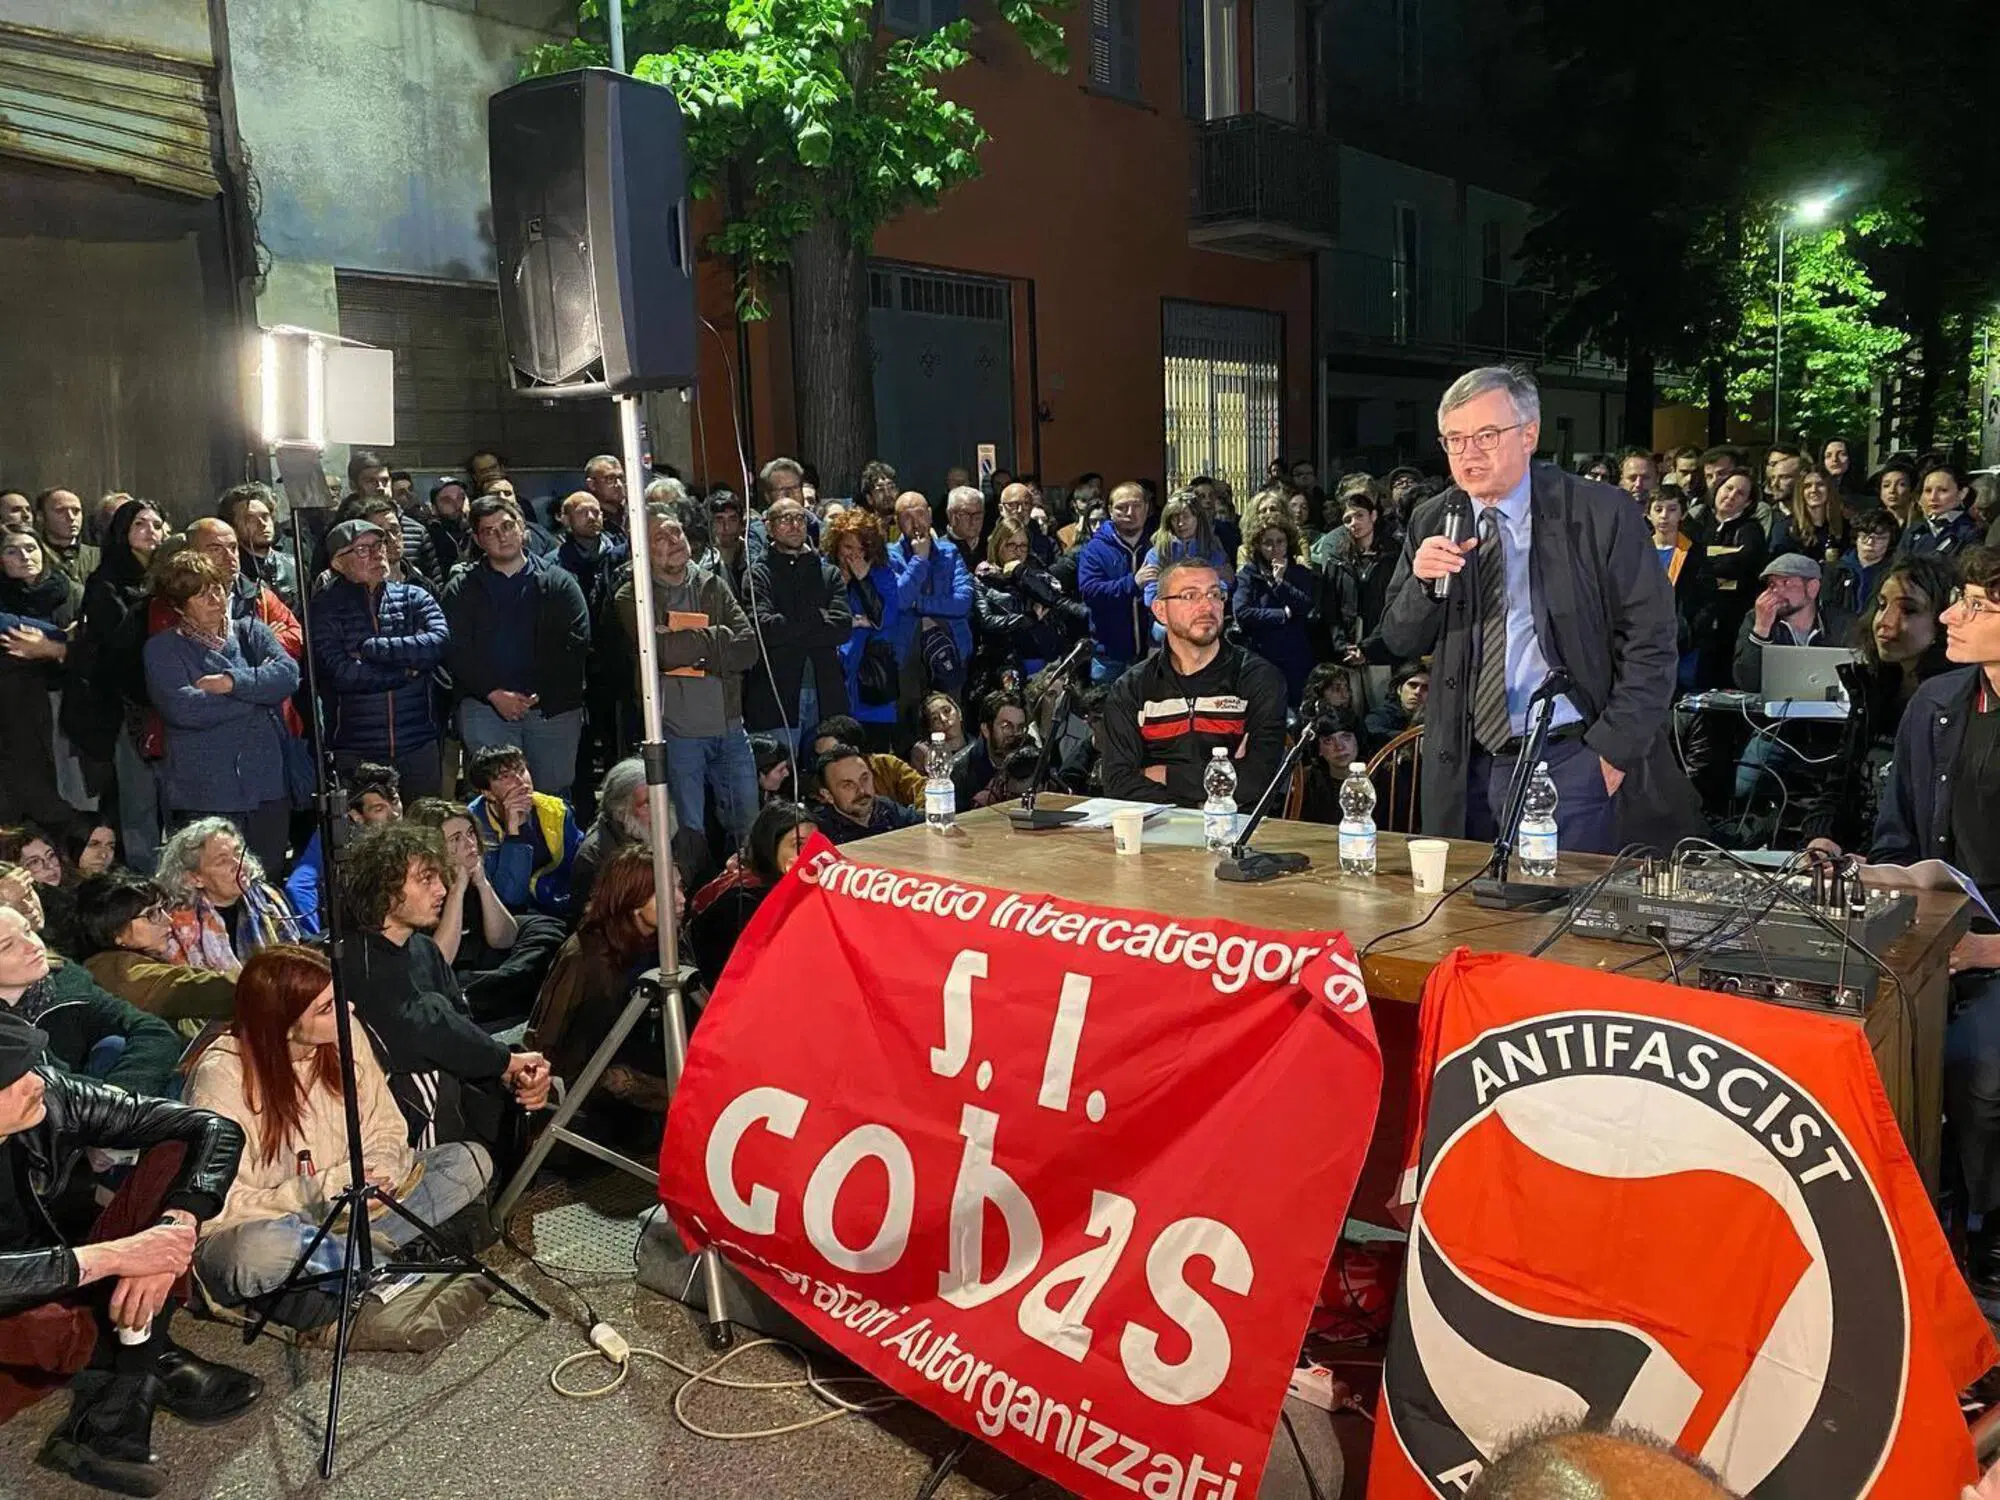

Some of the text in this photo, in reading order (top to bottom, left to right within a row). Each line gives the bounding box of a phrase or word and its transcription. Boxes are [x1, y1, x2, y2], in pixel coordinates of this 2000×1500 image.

[798, 849, 986, 921] Sindacato
[1471, 1022, 1853, 1185] ANTIFASCIST
[880, 1317, 1244, 1500] Autorganizzati
